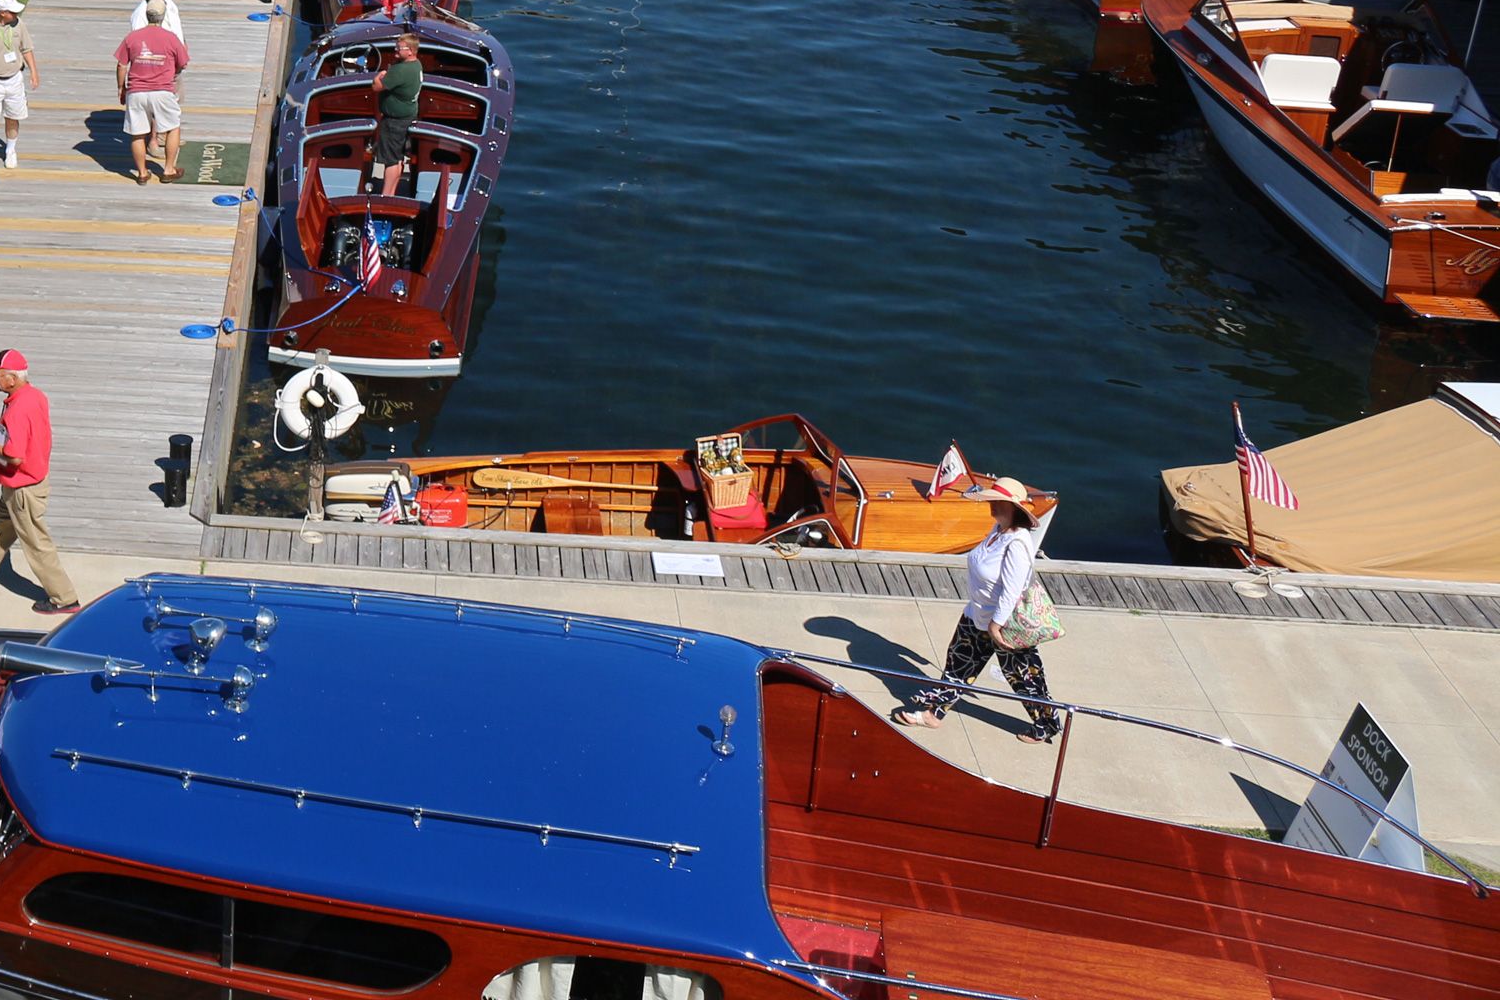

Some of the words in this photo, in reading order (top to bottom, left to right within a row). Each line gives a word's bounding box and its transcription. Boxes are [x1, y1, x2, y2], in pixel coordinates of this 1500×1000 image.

[1445, 248, 1499, 275] My
[1347, 733, 1389, 792] SPONSOR
[1362, 722, 1392, 763] DOCK
